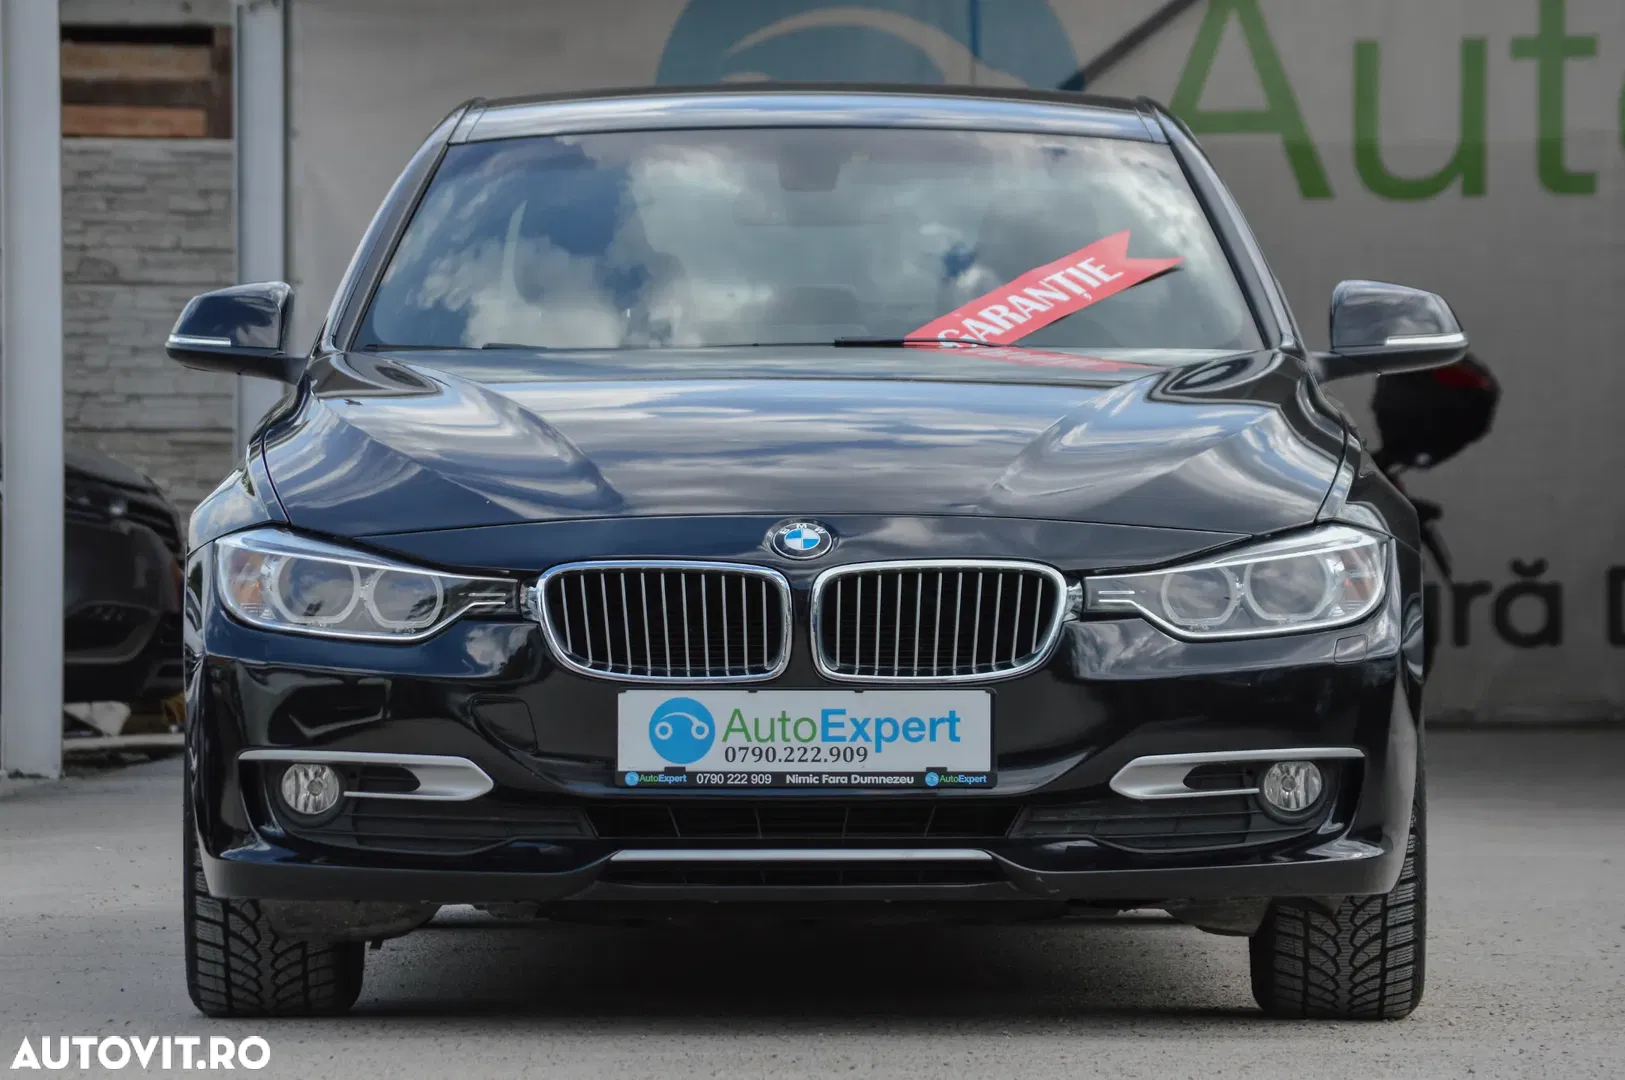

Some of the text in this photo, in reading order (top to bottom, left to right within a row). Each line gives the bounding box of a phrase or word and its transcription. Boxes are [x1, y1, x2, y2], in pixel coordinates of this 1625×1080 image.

[1168, 0, 1625, 201] Aut
[721, 708, 961, 753] AutoExpert
[724, 746, 868, 763] 0790.222.909
[639, 774, 687, 784] AutoExpert
[696, 773, 772, 785] 0790 222 909
[786, 773, 914, 785] Nimic Fara Dumnezeu
[939, 774, 987, 785] AutoExpert
